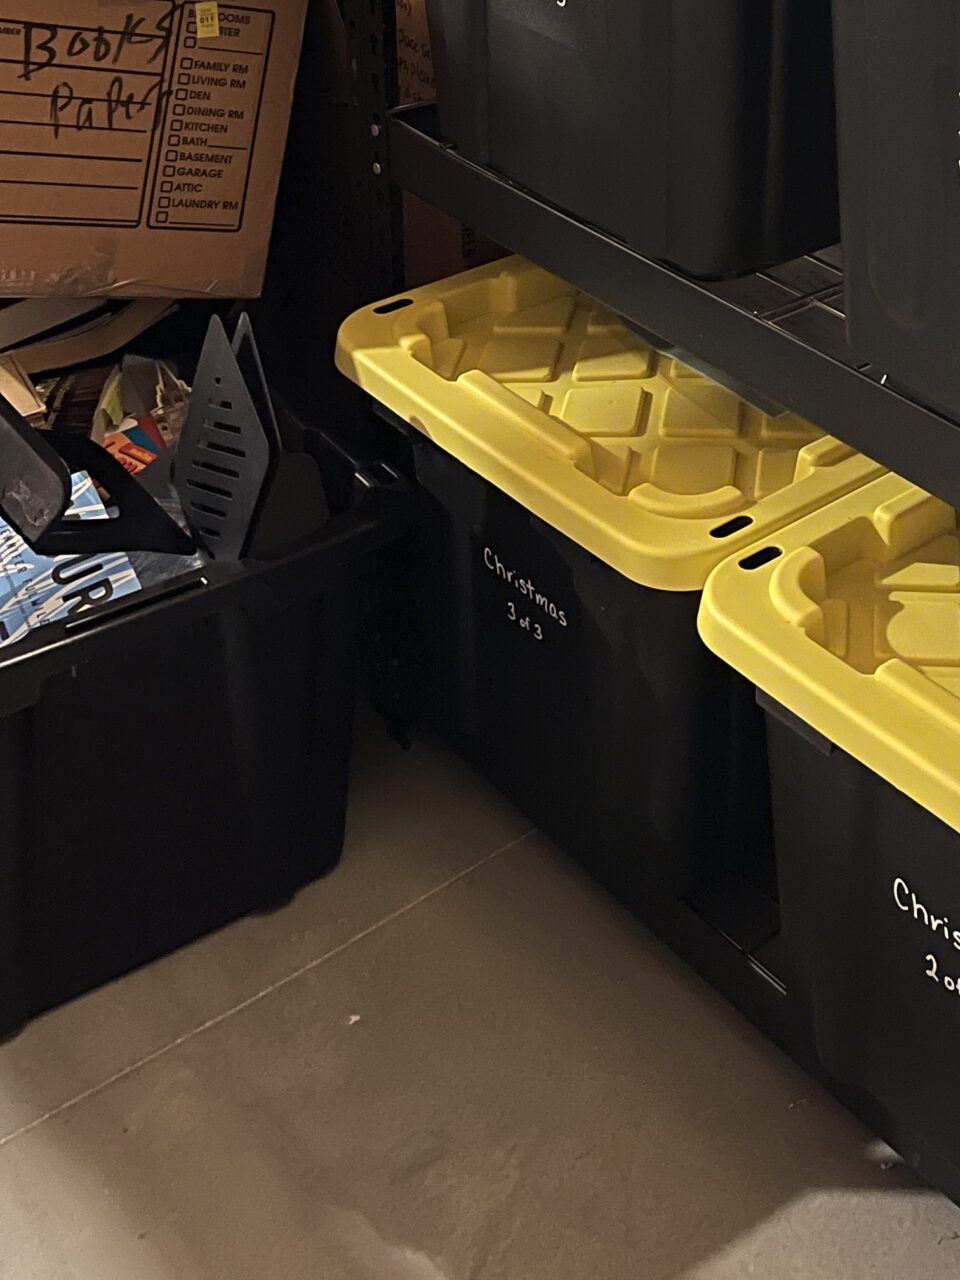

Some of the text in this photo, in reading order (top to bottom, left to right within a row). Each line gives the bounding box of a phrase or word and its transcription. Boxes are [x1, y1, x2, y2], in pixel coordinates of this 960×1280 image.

[188, 8, 250, 25] BOOMS
[219, 26, 241, 38] STER
[194, 60, 249, 75] FAMILY RM
[192, 75, 246, 89] LIVING RM
[189, 90, 211, 101] DEN
[186, 106, 245, 120] DINING RM
[184, 121, 228, 134] KITCHEN
[182, 136, 208, 146] BATH
[179, 152, 233, 164] BASEMENT
[176, 167, 224, 179] GARAGE
[174, 182, 203, 193] ATTIC
[171, 198, 239, 211] LAUNDRY RM
[484, 547, 567, 627] Christmas
[507, 602, 543, 640] 3 of 3
[925, 954, 939, 983] 2
